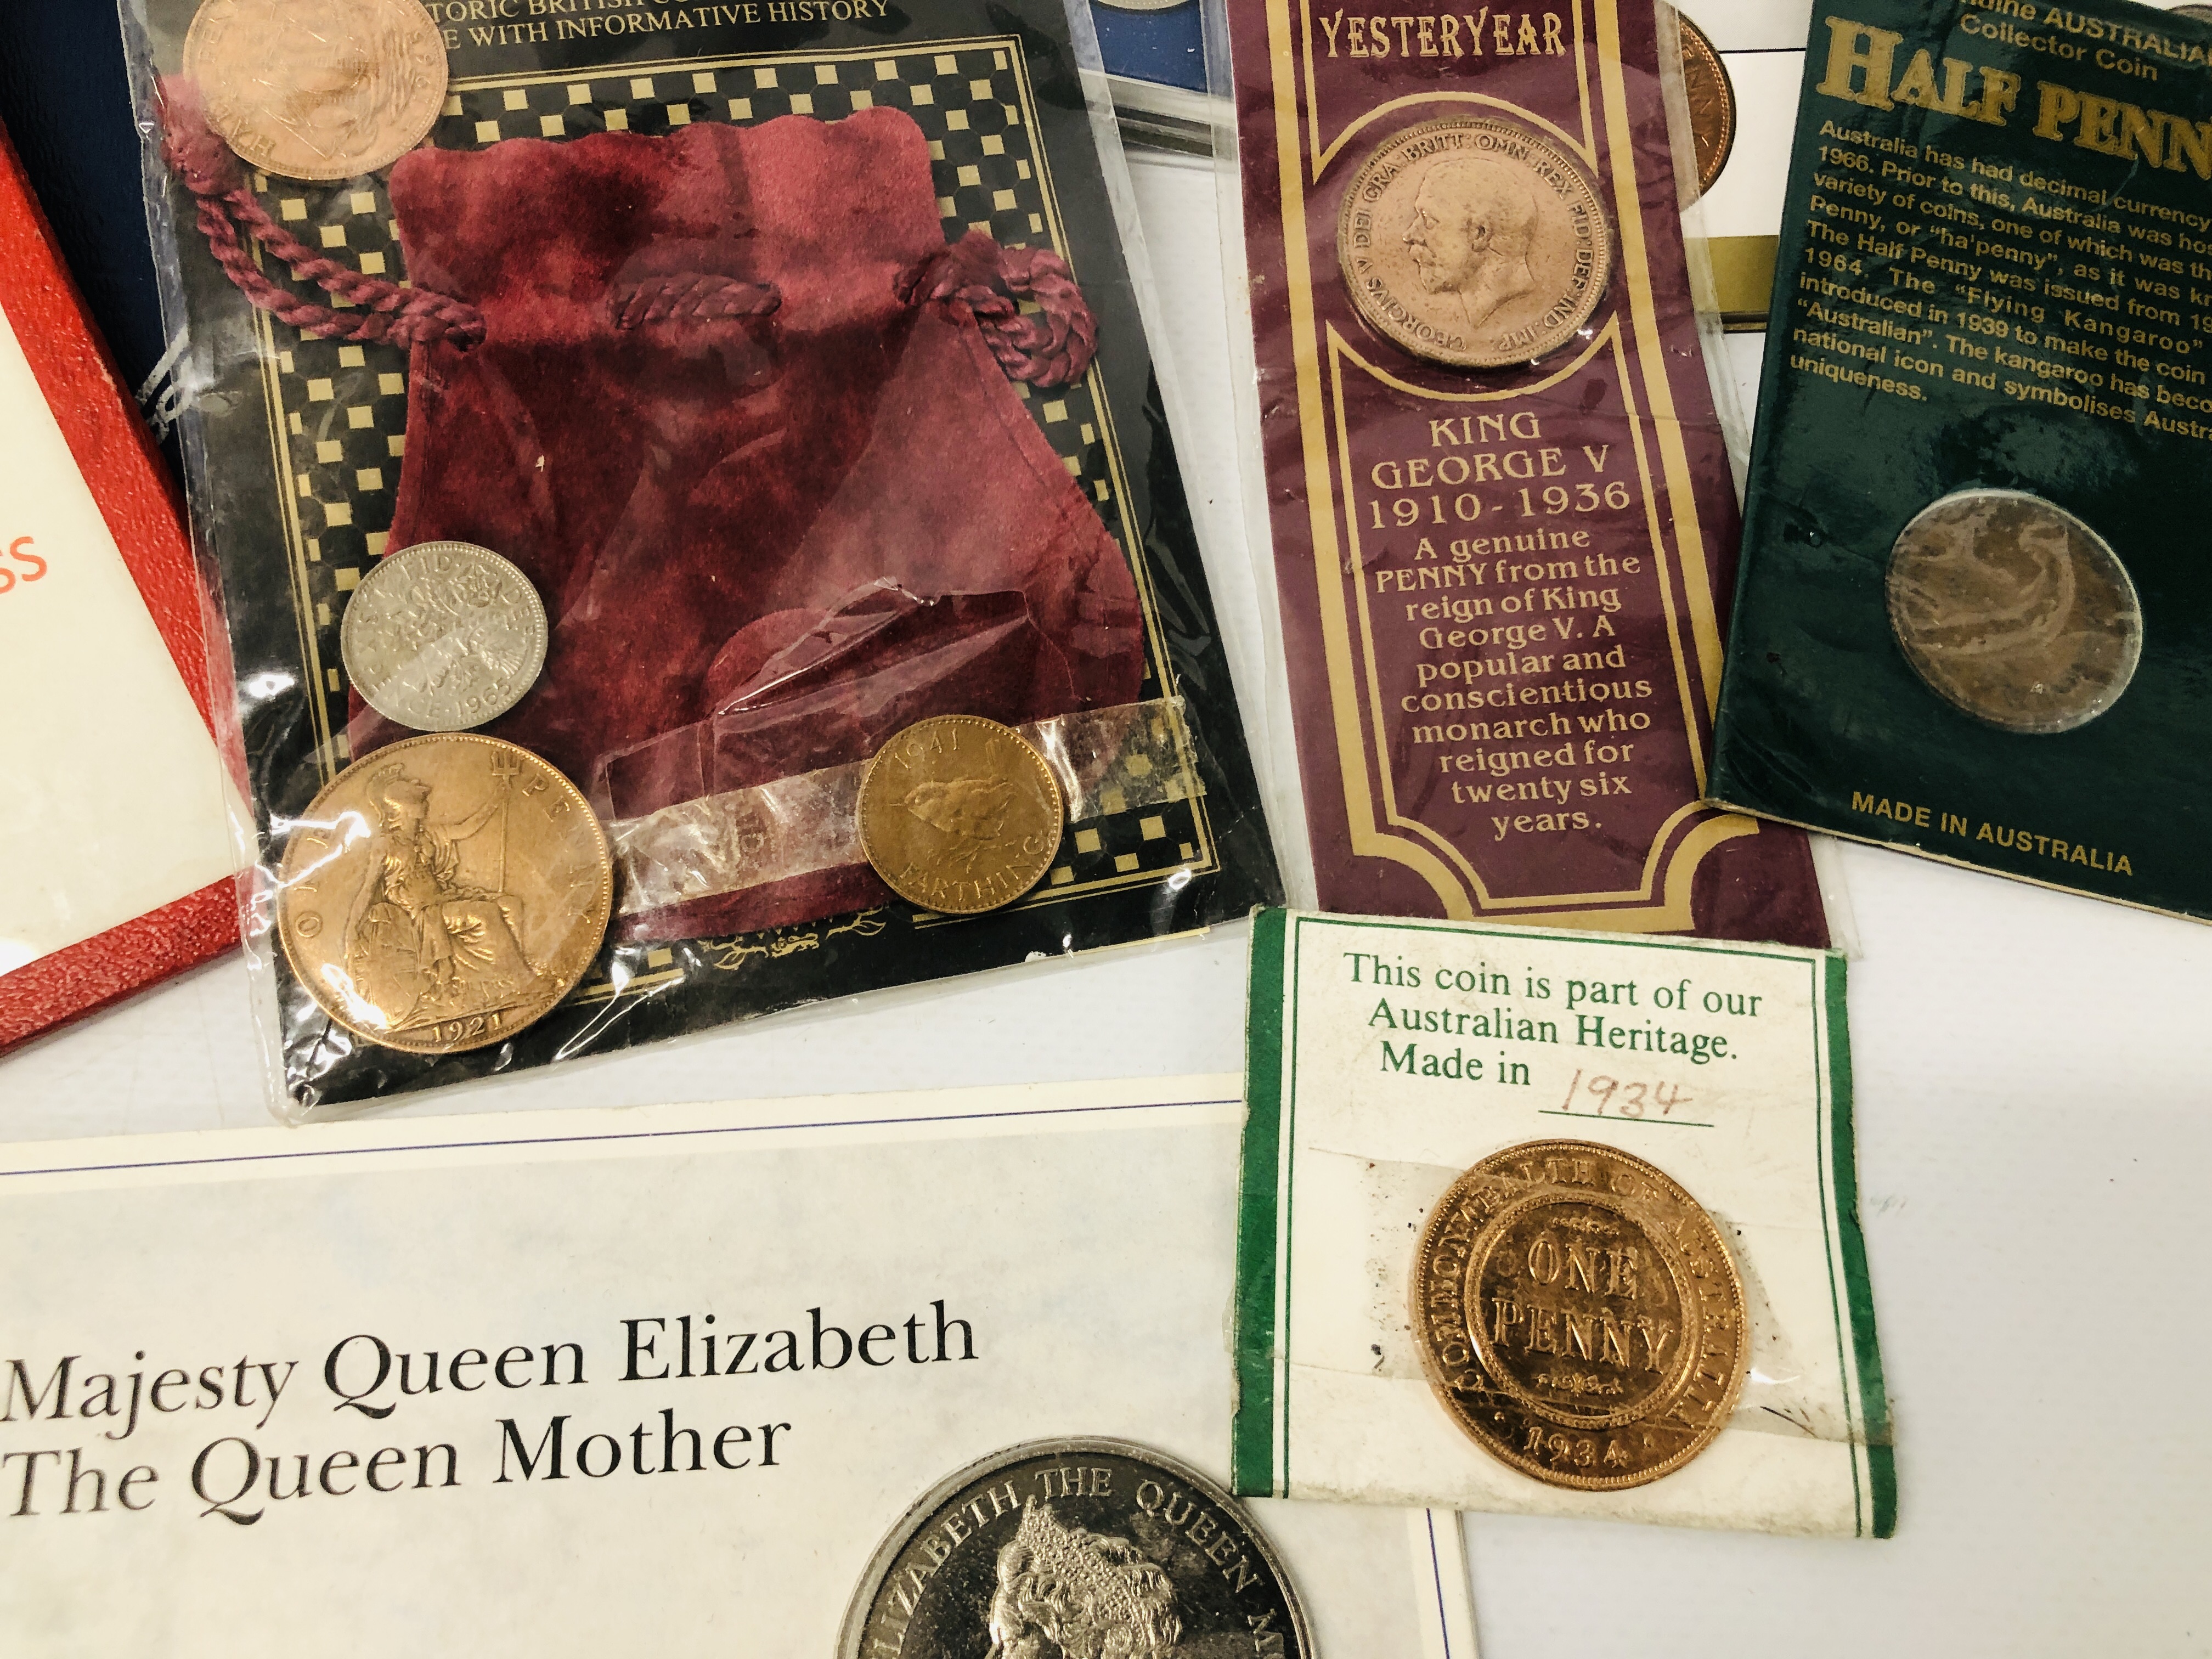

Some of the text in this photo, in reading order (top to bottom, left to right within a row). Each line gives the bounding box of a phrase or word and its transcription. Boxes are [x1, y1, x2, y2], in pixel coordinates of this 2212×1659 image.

[468, 21, 549, 47] WITH
[555, 3, 761, 41] INFORMATIVE
[768, 0, 888, 22] HISTORY
[1318, 6, 1567, 58] YESTERYEAR
[1960, 13, 2159, 82] Collector Coin
[2043, 7, 2212, 66] AUSTRALIA
[1816, 15, 2021, 127] HALF
[1533, 159, 1573, 200] REX
[1818, 145, 1874, 174] 1966.
[1881, 161, 1937, 188] Prior
[1941, 176, 1965, 196] to
[1970, 183, 2016, 212] this,
[2021, 196, 2121, 234] Australia
[2128, 224, 2172, 246] was
[1819, 120, 2211, 233] Australia has had decimal currency
[1353, 208, 1372, 249] DEI
[1810, 194, 1886, 232] Penny,
[1895, 221, 1922, 237] or
[2074, 263, 2101, 280] as
[2110, 268, 2126, 287] it
[2134, 277, 2181, 299] was
[1813, 171, 1887, 206] variety
[1893, 192, 1916, 210] of
[1921, 200, 1986, 230] coins,
[1991, 218, 2034, 239] one
[2039, 229, 2063, 245] of
[2067, 235, 2132, 262] which
[2140, 253, 2185, 274] was
[1804, 247, 1869, 279] 1964.
[1889, 267, 1936, 294] The
[1807, 219, 1850, 246] The
[1857, 233, 1905, 259] Half
[1910, 246, 1982, 281] Penny
[1990, 269, 2036, 291] was
[2044, 278, 2120, 312] issued
[2127, 298, 2181, 326] from
[1366, 276, 1467, 351] GEORGIVS
[1799, 272, 2205, 385] introduced in 1939 to make the coin
[1790, 354, 1928, 402] uniqueness.
[1793, 328, 1886, 363] national
[1893, 350, 1944, 377] icon
[1951, 368, 1996, 390] and
[2004, 379, 2136, 423] symbolises
[1945, 334, 1988, 360] The
[1994, 346, 2104, 387] kangaroo
[2110, 374, 2150, 399] has
[1428, 410, 1542, 448] KING
[1372, 444, 1610, 490] GEORGE V
[1414, 528, 1591, 563] A genuine
[1375, 554, 1641, 593] PENNY from the
[1406, 587, 1622, 624] reign of King
[1419, 615, 1616, 650] George V. A
[1417, 645, 1627, 688] popular and
[1401, 678, 1653, 713] conscientious
[1413, 709, 1651, 744] monarch who
[1438, 740, 1635, 777] reigned for
[1451, 772, 1632, 805] twenty six
[1491, 811, 1602, 842] years.
[1852, 791, 2134, 877] MADE IN AUSTRALIA
[1344, 952, 1763, 1017] This coin is part of our
[431, 1013, 504, 1043] 1921
[1368, 997, 1738, 1065] Australian Heritage.
[1380, 1041, 1531, 1086] Made in
[1561, 1068, 1693, 1119] 1934
[1528, 1231, 1638, 1300] ONE
[1491, 1297, 1675, 1375] PENNY
[0, 1299, 980, 1440] Majesty Queen Elizabeth
[2, 1408, 792, 1526] The Queen Mother
[1523, 1426, 1629, 1469] 1934
[1035, 1466, 1115, 1500] THE
[1136, 1480, 1263, 1594] QUEEN
